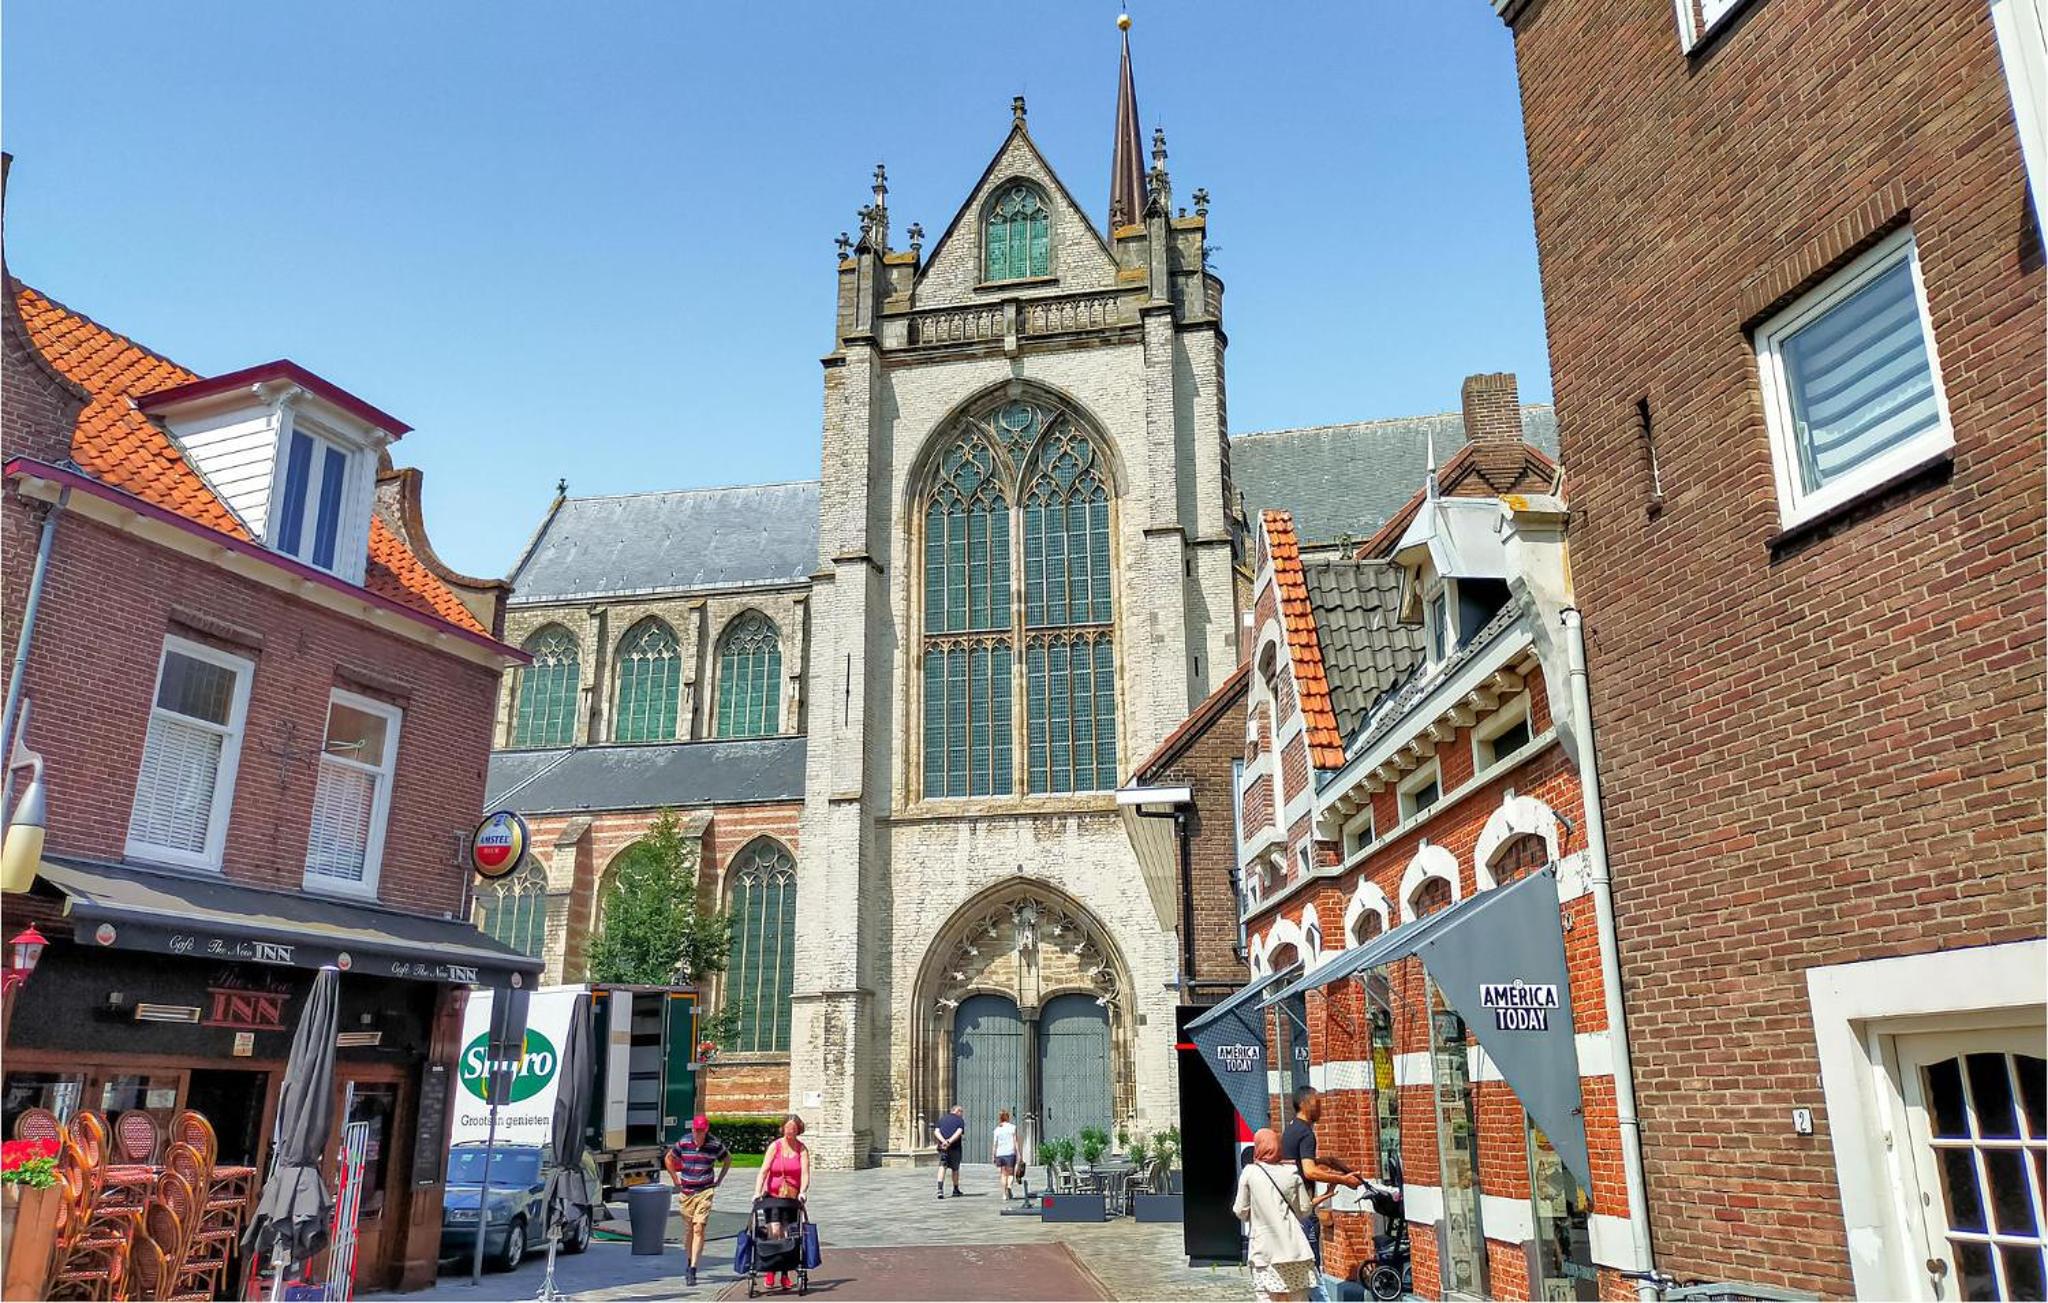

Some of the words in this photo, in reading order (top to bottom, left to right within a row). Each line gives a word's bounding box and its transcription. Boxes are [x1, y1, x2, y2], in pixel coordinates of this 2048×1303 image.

[480, 835, 509, 844] AMSTEL
[207, 939, 225, 953] The
[227, 943, 252, 957] New
[253, 941, 294, 964] INN
[447, 965, 479, 982] INN
[1483, 986, 1557, 1007] AMERICA
[205, 989, 287, 1028] INN
[1496, 1009, 1545, 1030] TODAY
[1218, 1046, 1259, 1059] AMERICA
[1226, 1060, 1252, 1072] TODAY
[506, 1113, 550, 1128] genieten
[1798, 1111, 1807, 1131] 2
